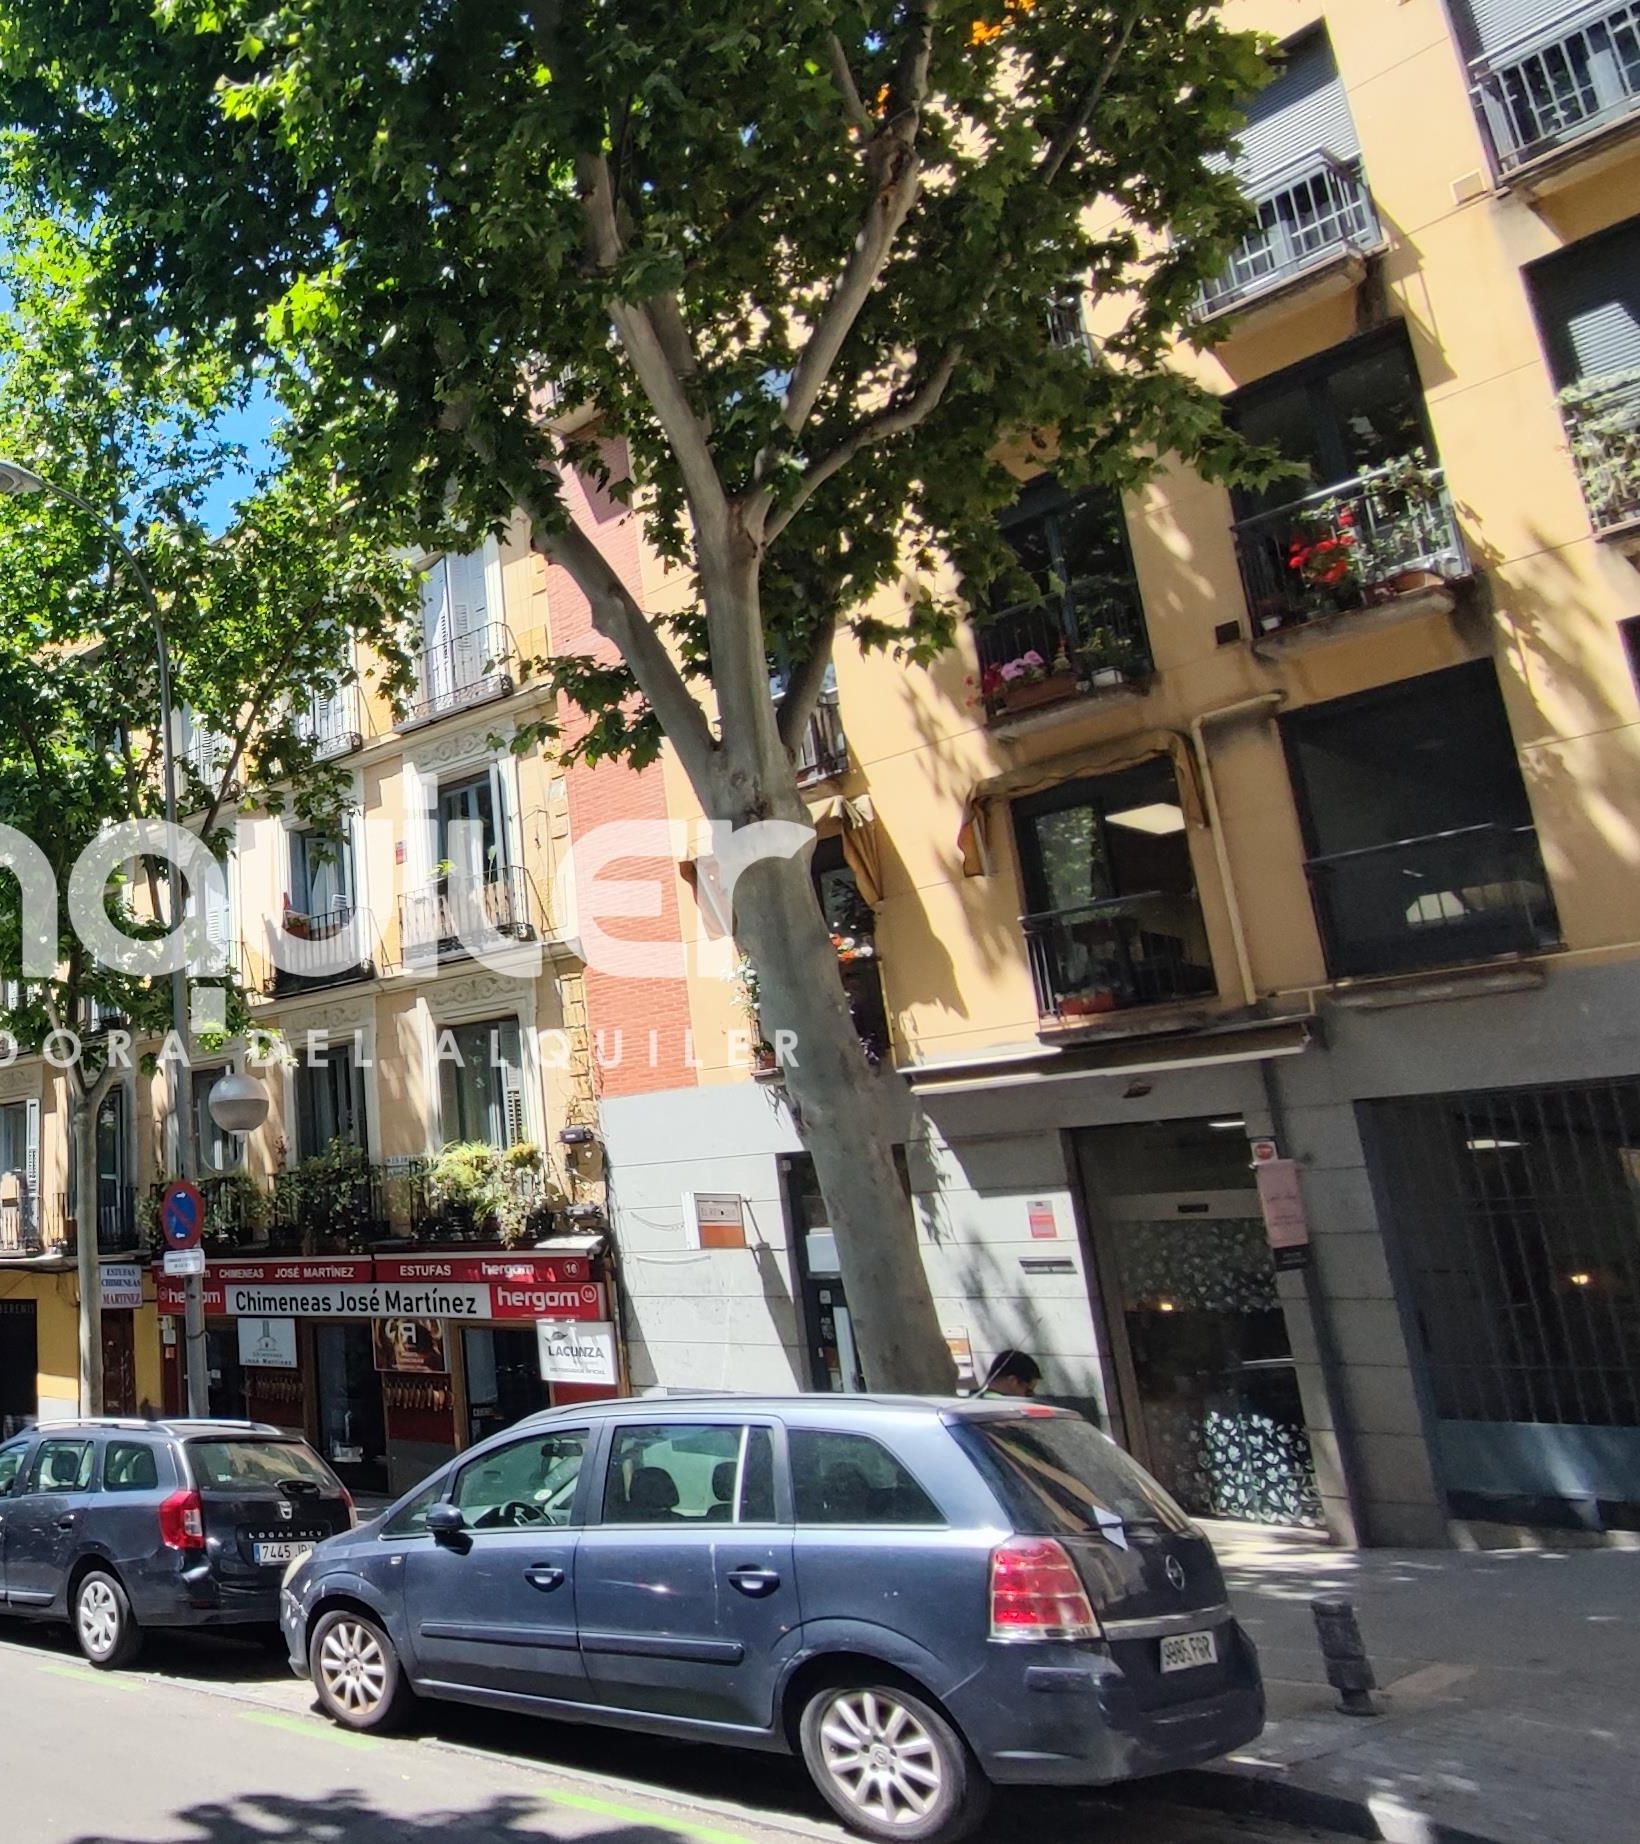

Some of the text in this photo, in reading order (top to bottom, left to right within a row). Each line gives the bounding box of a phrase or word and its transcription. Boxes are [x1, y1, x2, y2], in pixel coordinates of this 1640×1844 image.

[219, 1267, 264, 1279] CHIMENEAS
[275, 1266, 300, 1279] JOSÉ
[303, 1264, 355, 1278] MARTÍNEZ
[399, 1264, 451, 1277] ESTUFAS
[236, 1287, 477, 1314] Chimeneas José Martínez
[497, 1286, 580, 1312] hergom
[547, 1345, 605, 1359] LACUNZA
[249, 1531, 293, 1539] LOGAN
[262, 1544, 291, 1559] 7445
